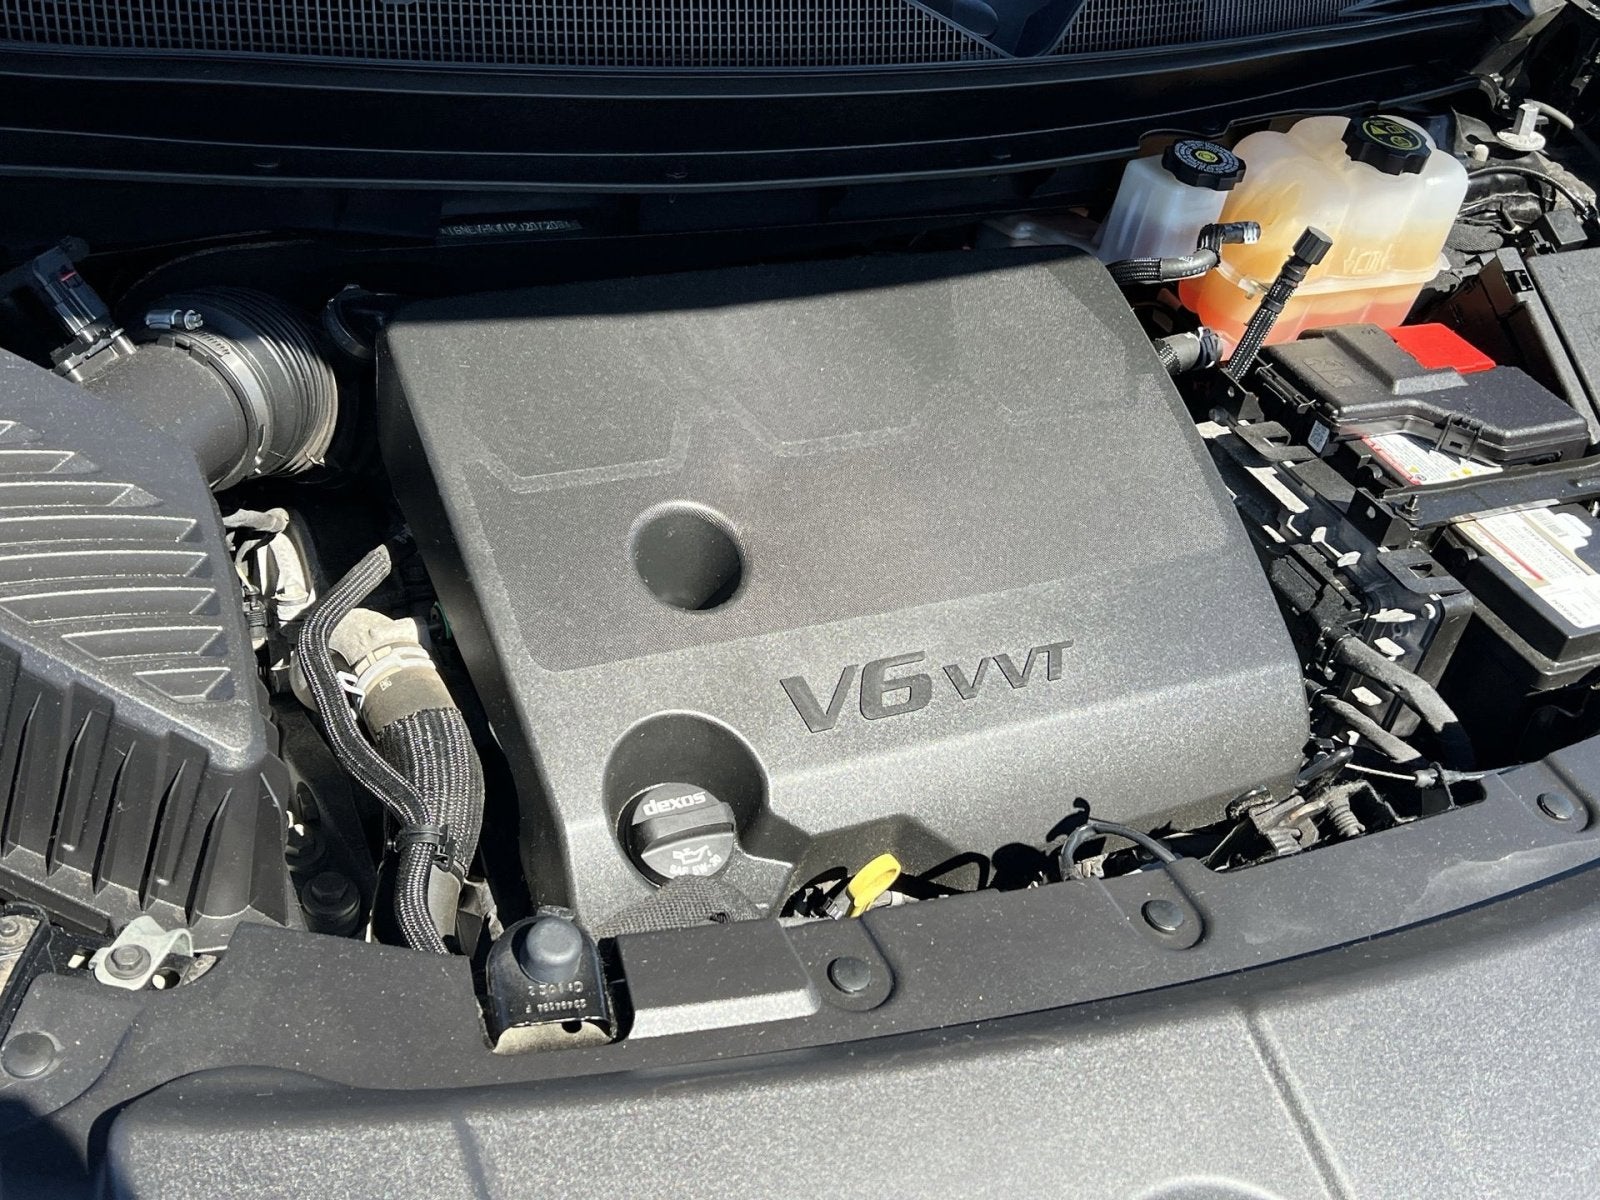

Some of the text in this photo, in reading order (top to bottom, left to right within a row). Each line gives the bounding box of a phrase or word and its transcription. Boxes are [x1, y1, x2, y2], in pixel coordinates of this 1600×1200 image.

[779, 639, 1075, 733] V6 VVT
[642, 791, 706, 816] dexos
